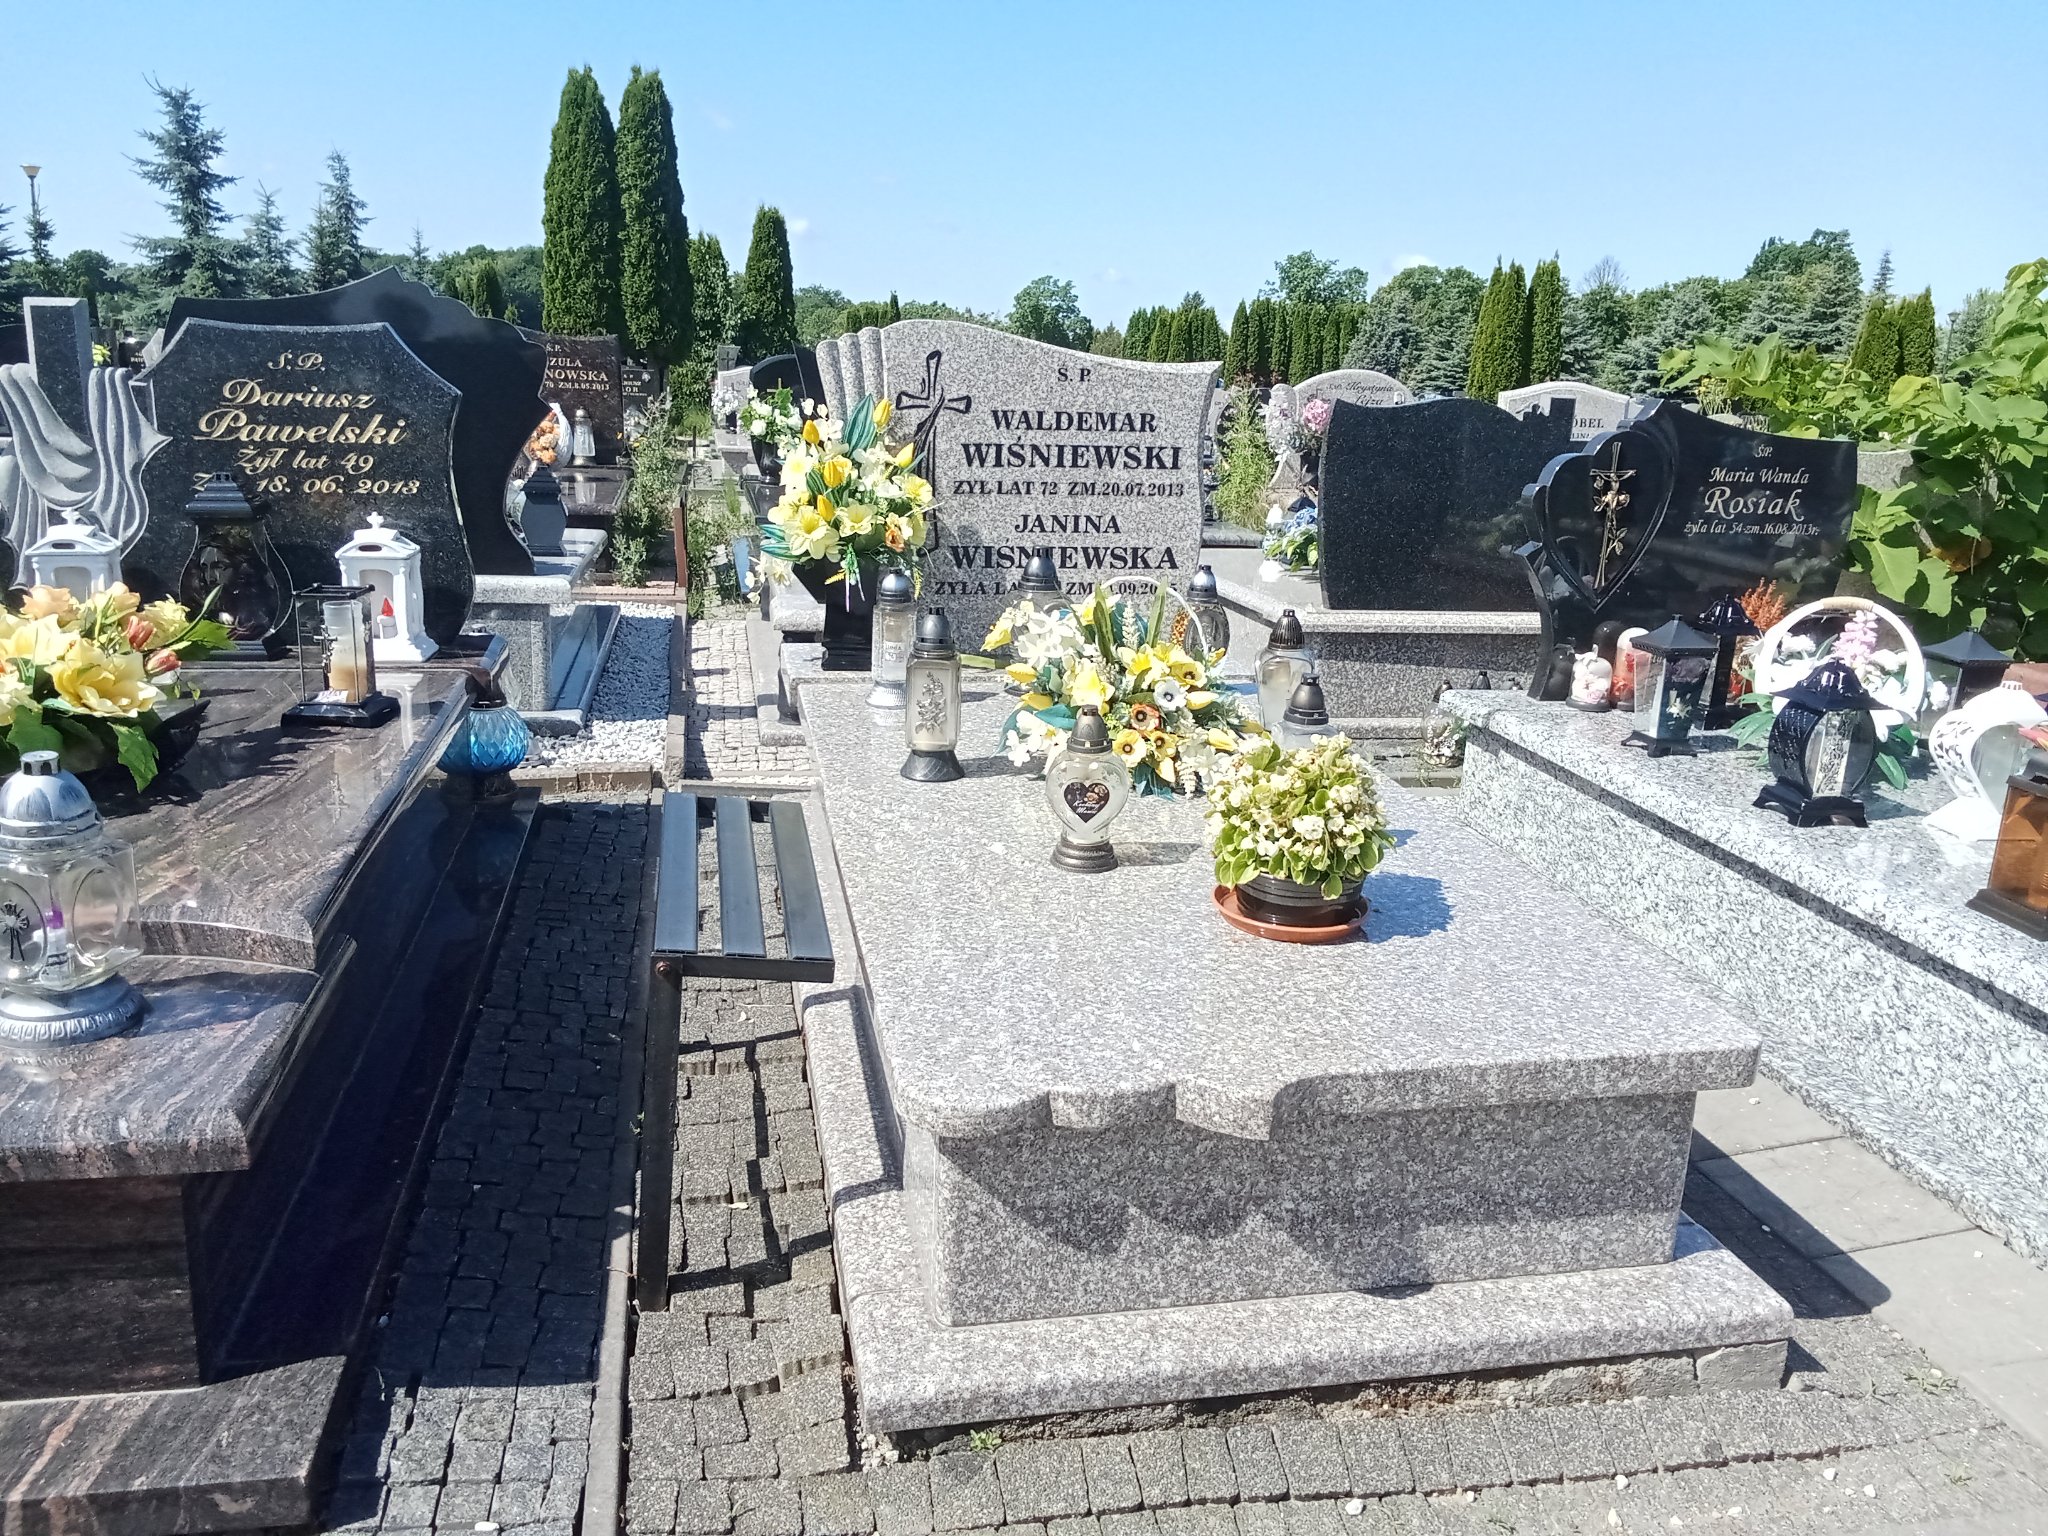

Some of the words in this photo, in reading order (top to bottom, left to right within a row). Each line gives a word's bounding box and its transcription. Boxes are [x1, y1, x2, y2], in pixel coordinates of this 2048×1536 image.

[550, 357, 582, 367] ZULA
[545, 369, 608, 381] NOWSKA
[219, 378, 376, 409] Dariusz
[192, 408, 409, 444] Pawelski
[991, 409, 1157, 432] WALDEMAR
[234, 445, 289, 474] Żył
[292, 450, 330, 469] lat
[341, 452, 374, 474] 49
[961, 436, 1182, 470] WIŚNIEWSKI
[256, 475, 291, 493] 18.
[303, 475, 344, 494] 06.
[354, 479, 420, 495] 2013
[1709, 467, 1755, 482] Maria
[1759, 467, 1810, 484] Wanda
[996, 480, 1034, 495] LAT
[1041, 481, 1058, 496] 72
[1704, 486, 1805, 522] Rosiak
[1014, 515, 1121, 534] JANINA
[1711, 520, 1726, 534] lat
[951, 539, 1179, 569] WIŚNEWSKA
[994, 581, 1019, 595] LA
